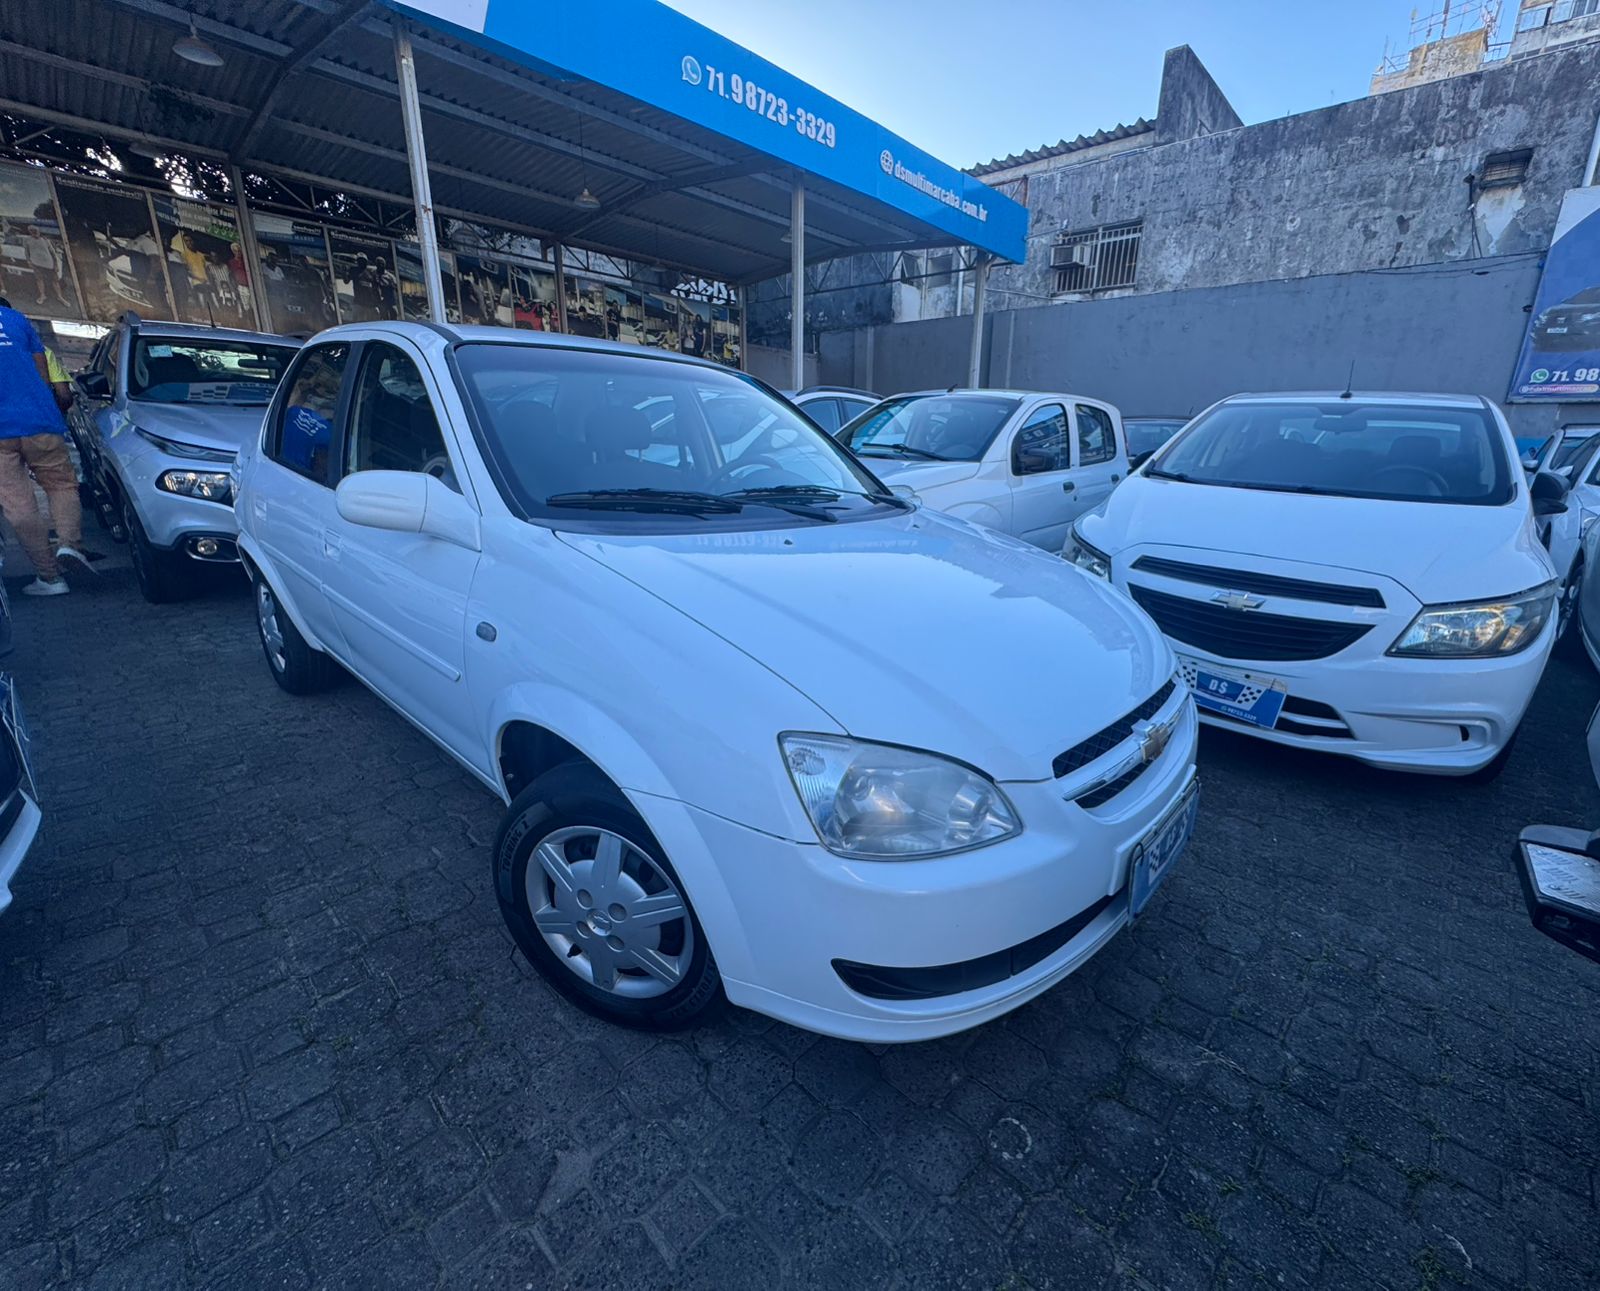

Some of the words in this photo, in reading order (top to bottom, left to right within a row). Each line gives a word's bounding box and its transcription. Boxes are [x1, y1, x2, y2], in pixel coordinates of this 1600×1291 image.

[705, 65, 836, 148] 71.98723-3329
[1551, 370, 1569, 382] 71.
[1573, 367, 1600, 382] 98
